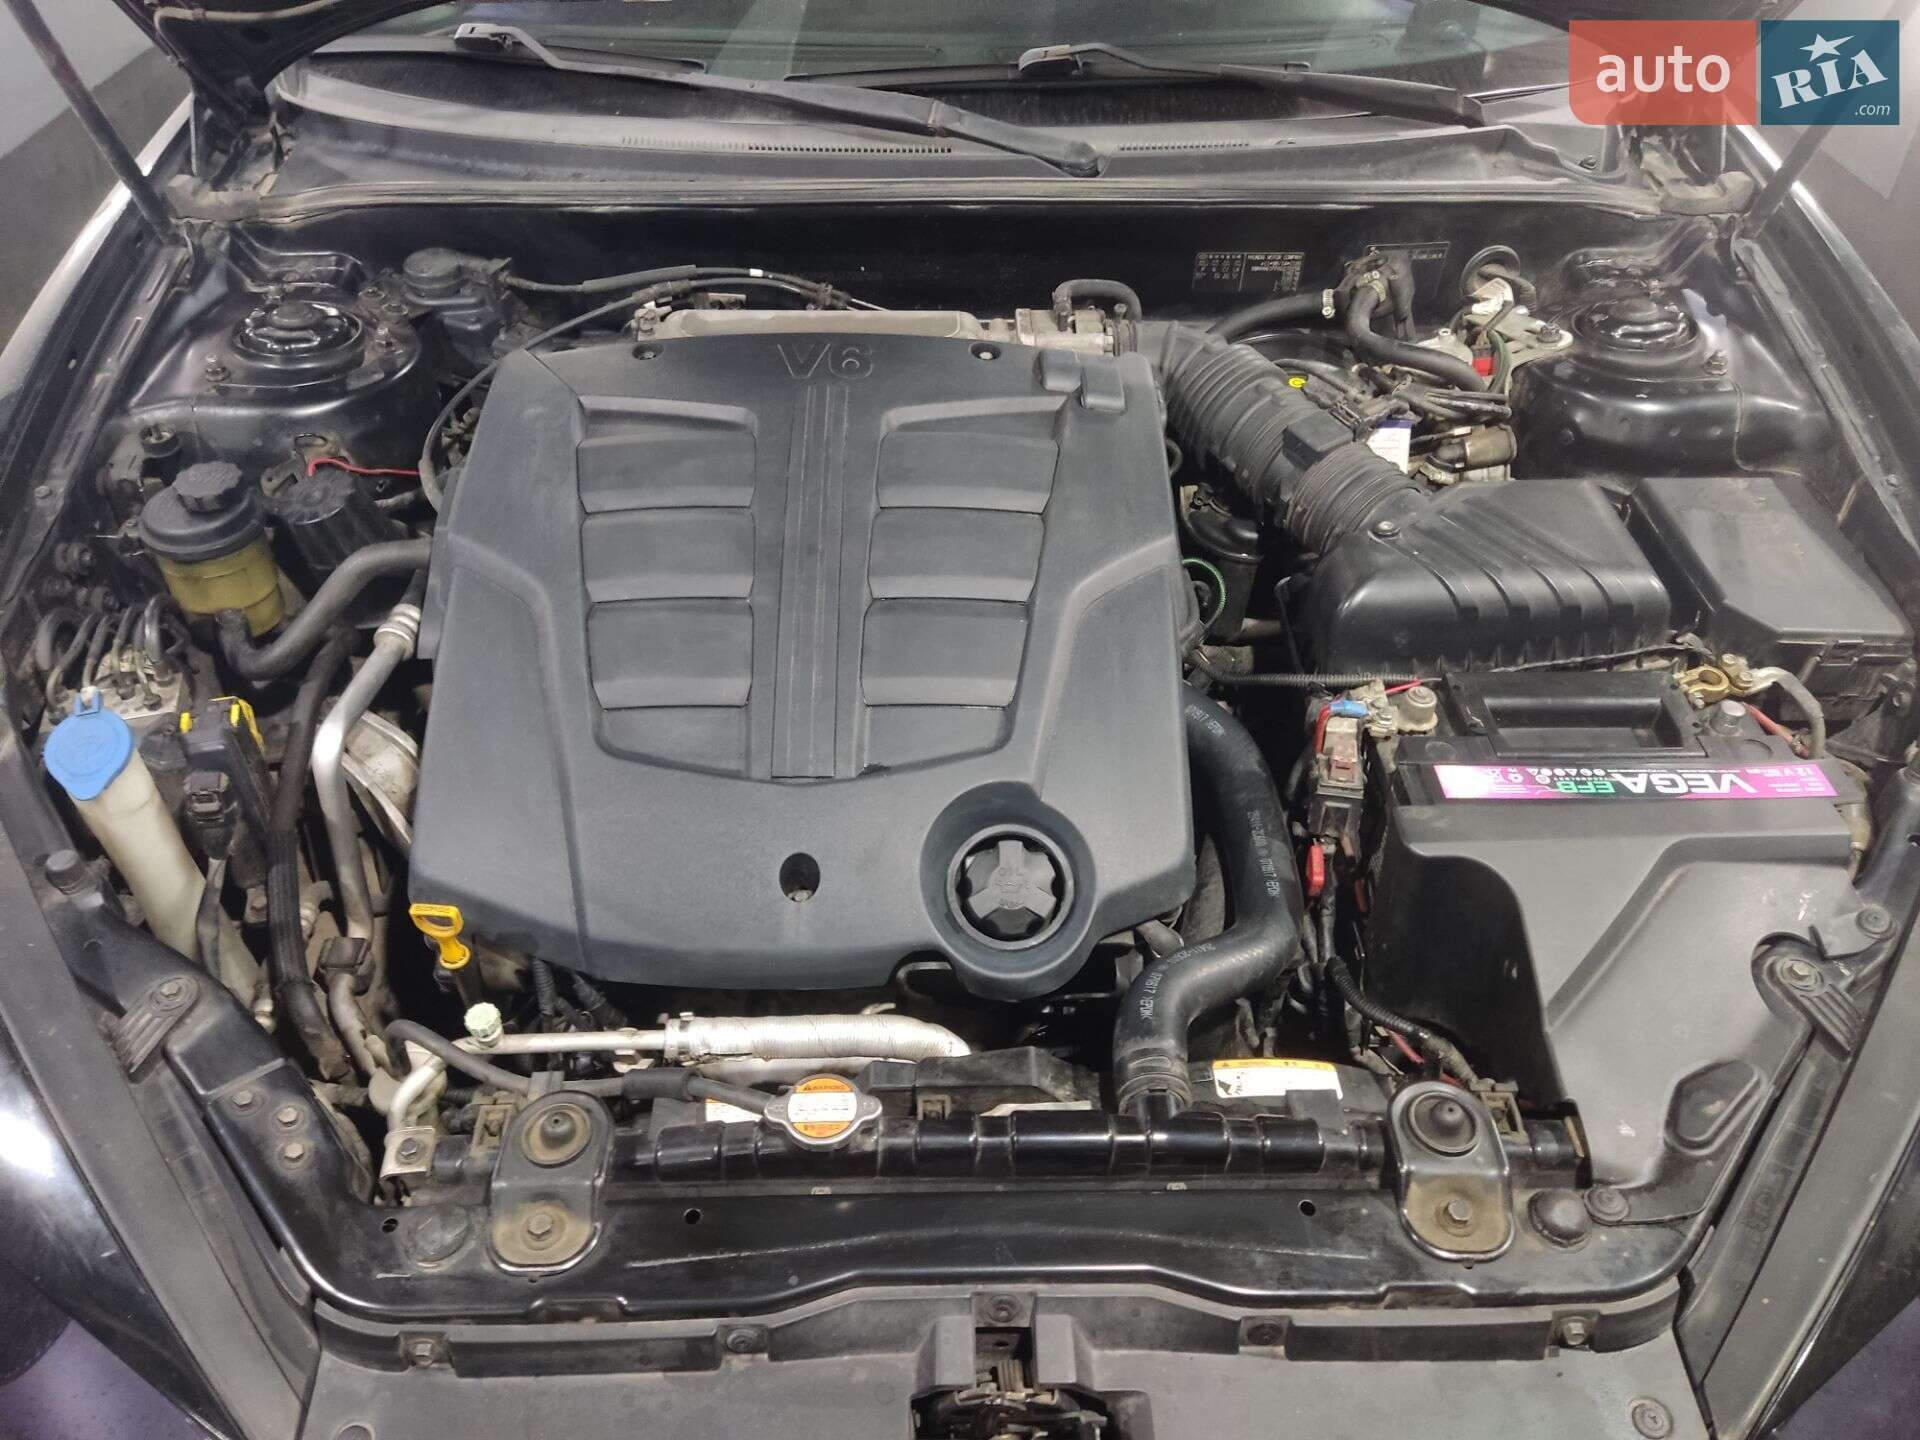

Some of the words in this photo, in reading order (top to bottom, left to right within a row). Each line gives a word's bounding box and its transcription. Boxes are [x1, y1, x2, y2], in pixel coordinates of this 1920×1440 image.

[777, 343, 875, 379] V6
[1557, 780, 1616, 794] EFB
[1612, 773, 1757, 793] VEGA
